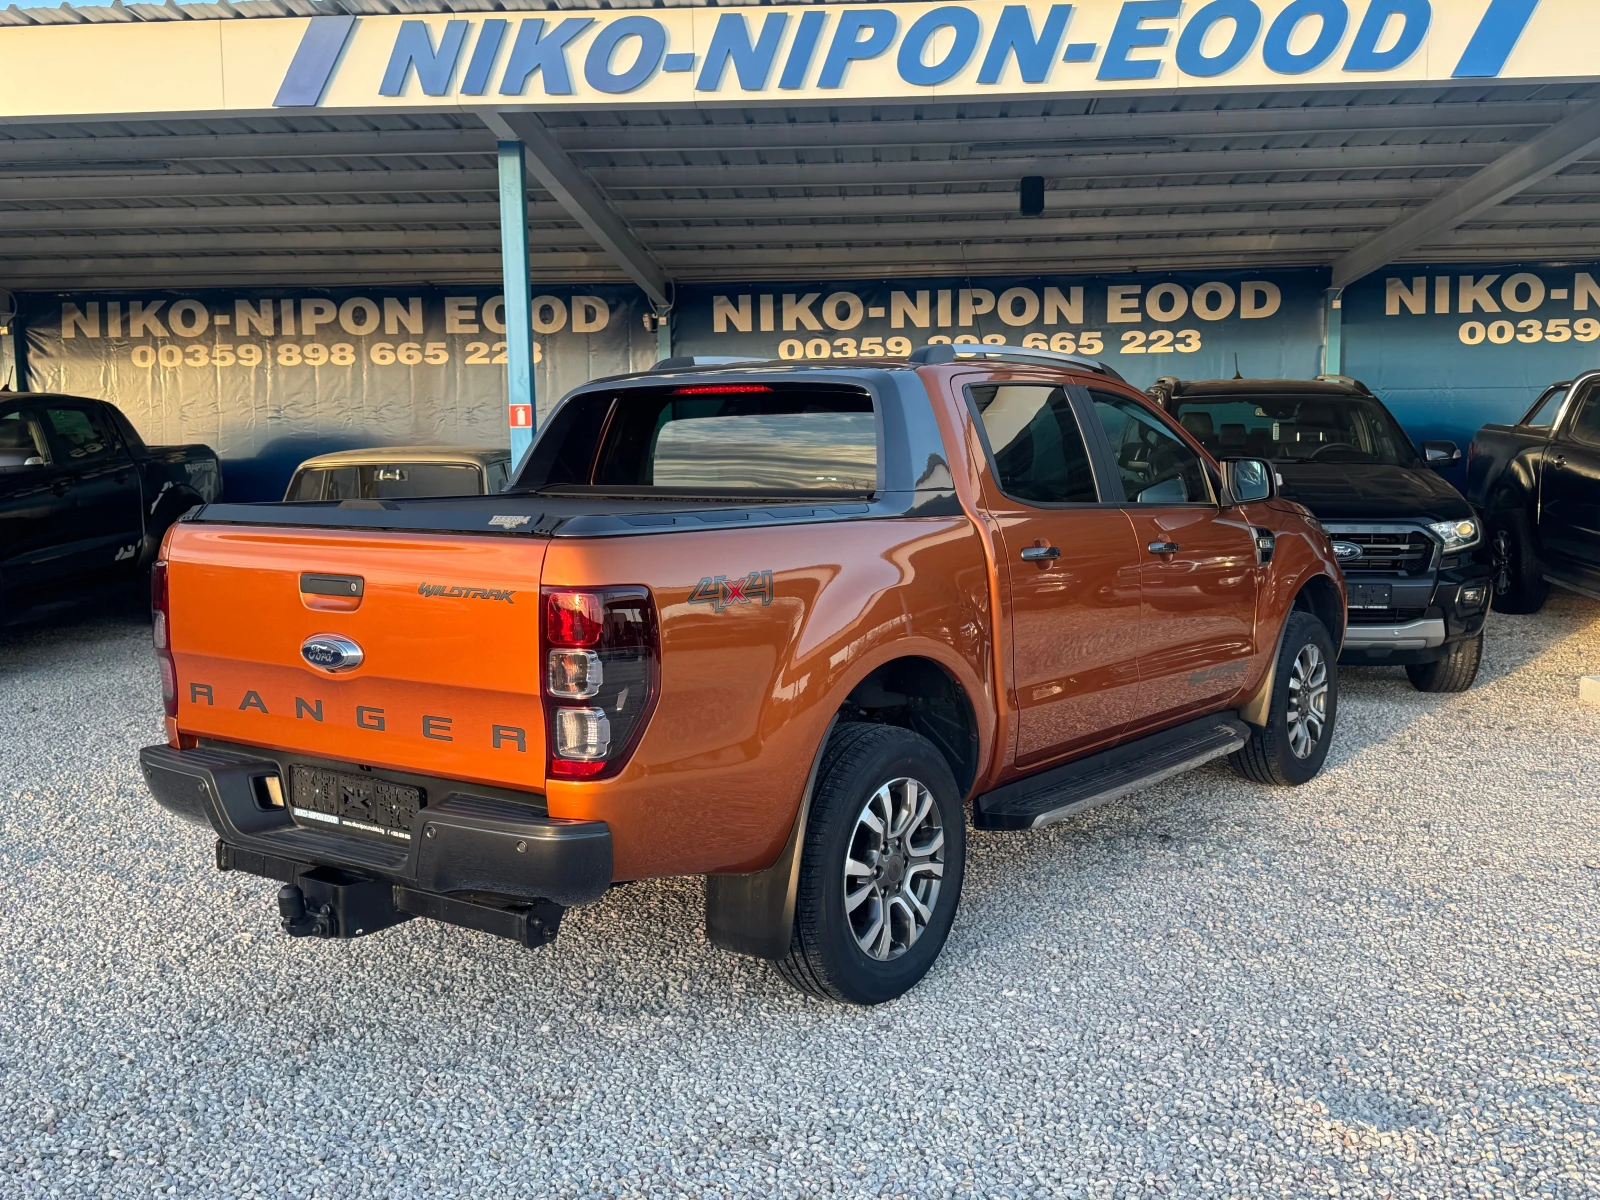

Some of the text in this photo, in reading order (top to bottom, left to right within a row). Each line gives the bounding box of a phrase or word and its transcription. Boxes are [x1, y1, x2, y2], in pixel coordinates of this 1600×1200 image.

[378, 0, 1432, 95] NIKO-NIPON-EOOD
[61, 295, 610, 339] NIKO-NIPON EOOD
[712, 281, 1282, 333] NIKO-NIPON EOOD
[777, 336, 912, 360] 00359
[1119, 329, 1202, 354] 223
[1458, 317, 1600, 345] 00359
[130, 343, 263, 368] 00359
[276, 343, 356, 367] 898
[369, 342, 450, 365] 665
[417, 581, 517, 605] WILDTRAK
[308, 644, 334, 663] Ford
[189, 682, 527, 753] RANGER
